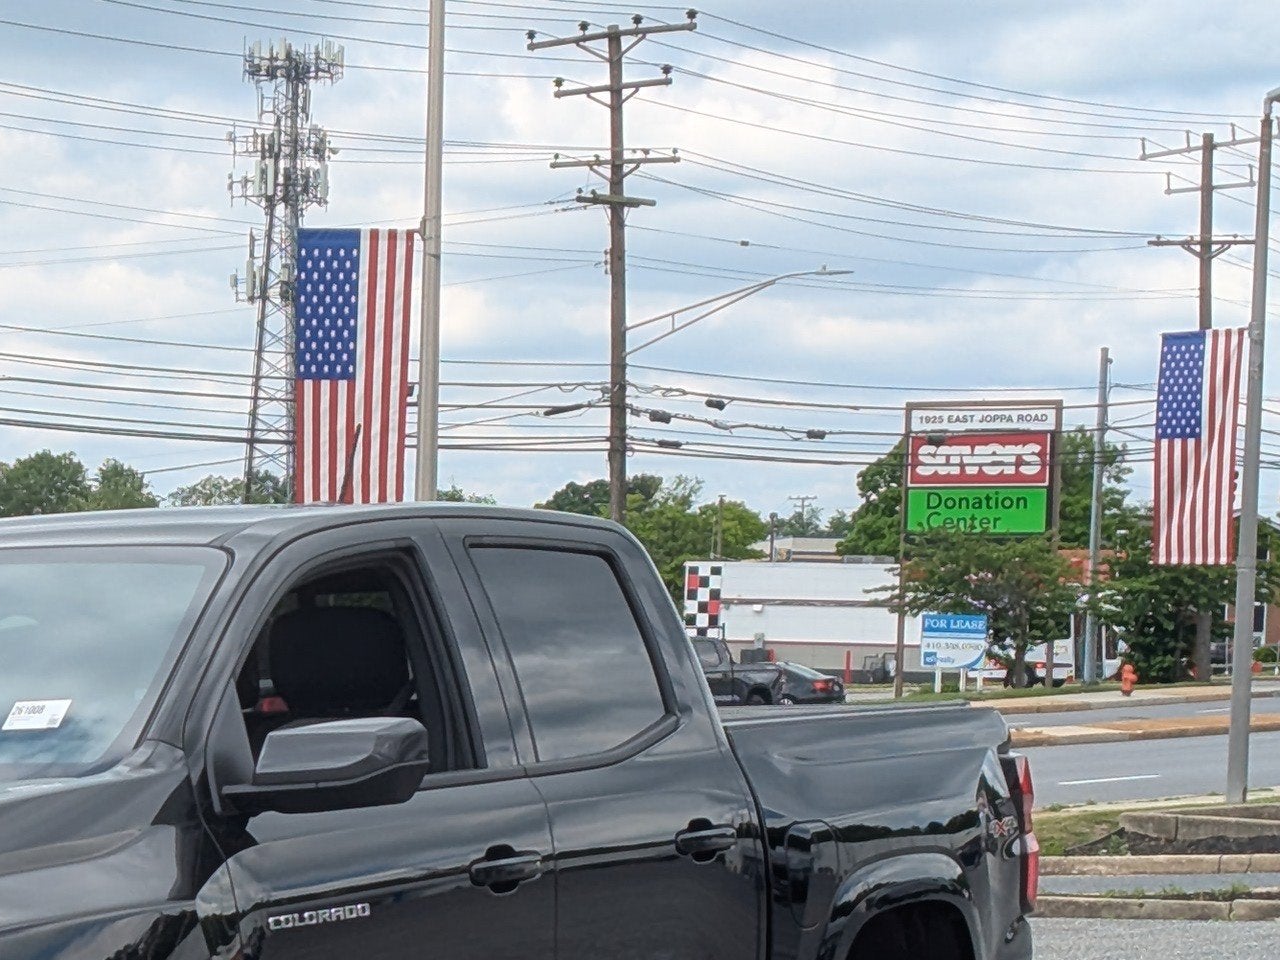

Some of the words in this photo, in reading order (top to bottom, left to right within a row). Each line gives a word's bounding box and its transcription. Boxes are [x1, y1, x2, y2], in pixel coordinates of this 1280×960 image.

[919, 415, 944, 424] 1925
[947, 414, 975, 423] EAST
[979, 414, 1014, 423] JOPPA
[1017, 413, 1048, 423] ROAD
[926, 491, 1028, 510] Donation
[926, 511, 1002, 530] Center
[924, 618, 947, 629] FOR
[950, 619, 986, 630] LEASE
[268, 903, 370, 930] COLORADO
